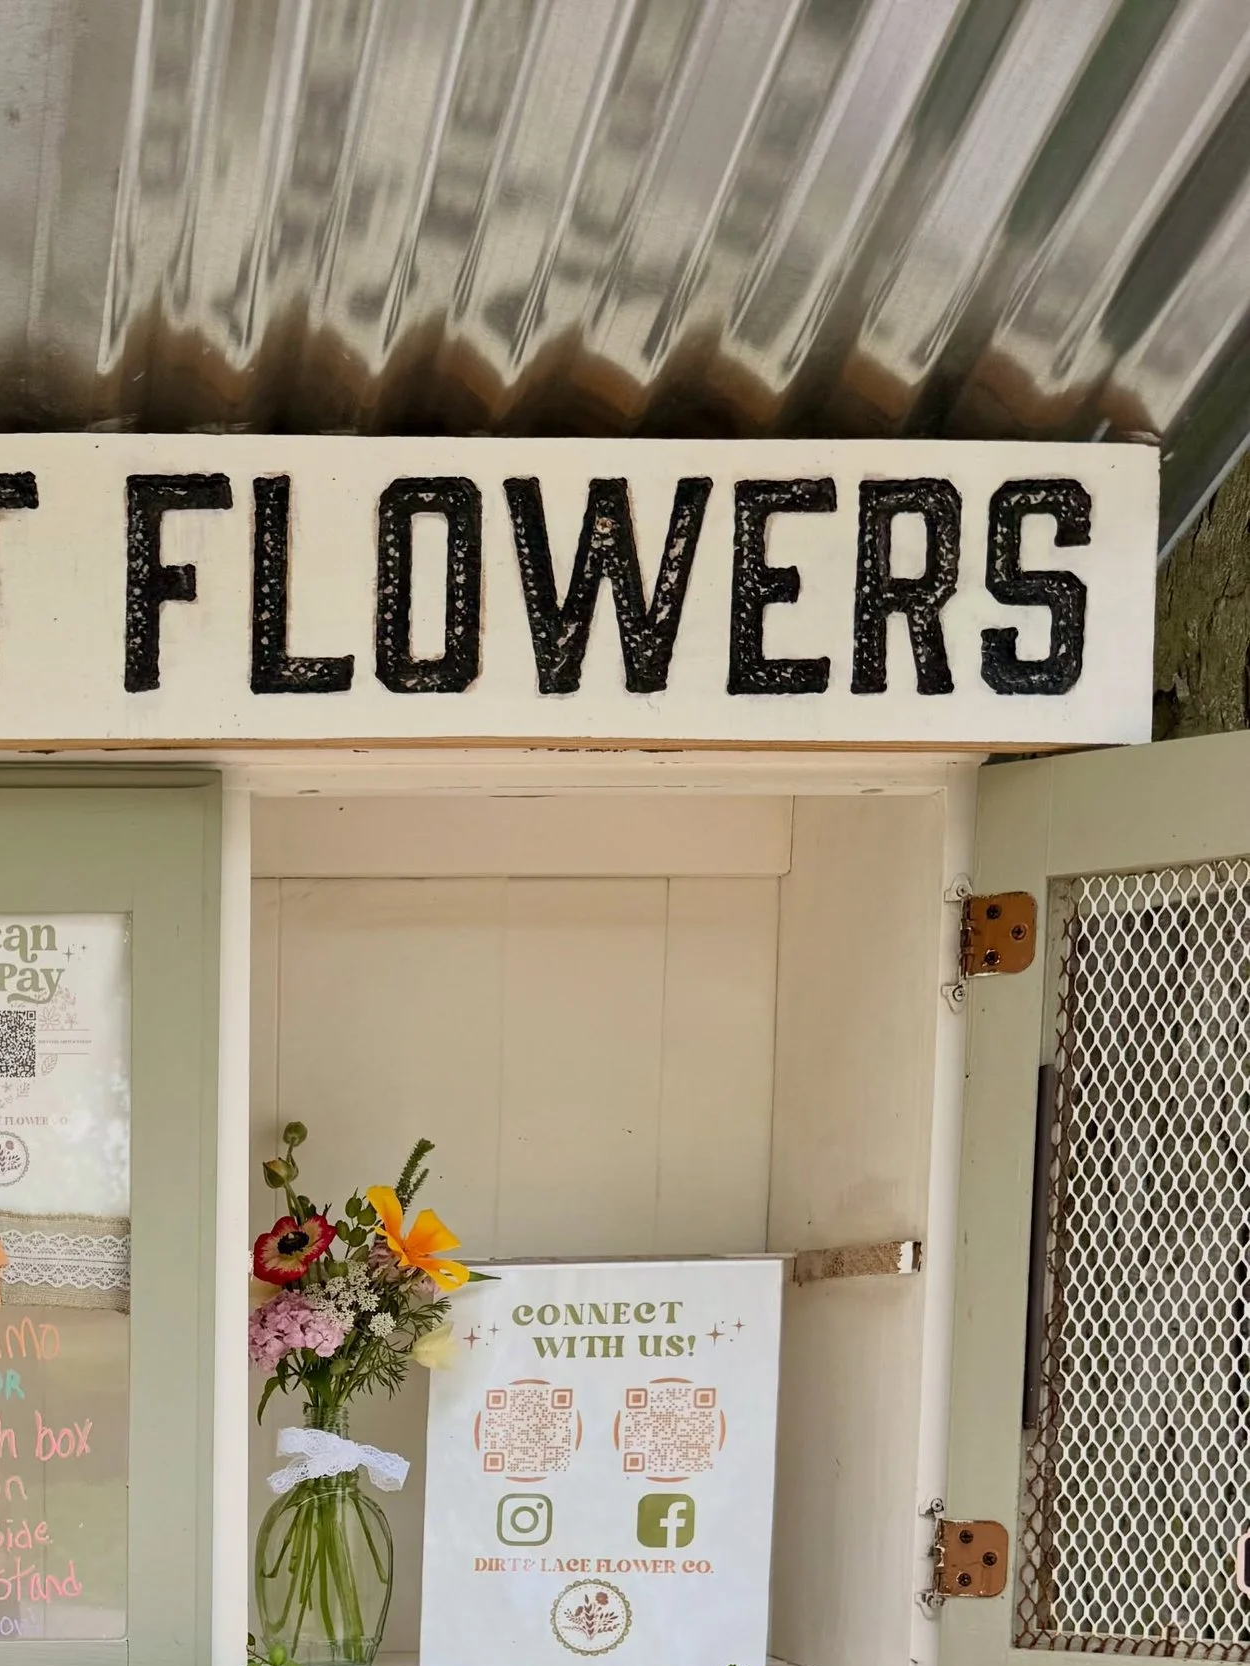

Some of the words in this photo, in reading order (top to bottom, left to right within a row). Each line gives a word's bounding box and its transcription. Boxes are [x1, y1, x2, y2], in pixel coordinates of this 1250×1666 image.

[124, 472, 1093, 695] FLOWERS
[511, 1301, 684, 1327] CONNECT
[532, 1334, 625, 1359] WITH
[637, 1334, 696, 1358] US!
[35, 1410, 93, 1462] box
[474, 1557, 522, 1573] DIRT
[540, 1558, 592, 1573] LACE
[596, 1559, 676, 1574] FLOWER
[681, 1560, 715, 1574] CO.
